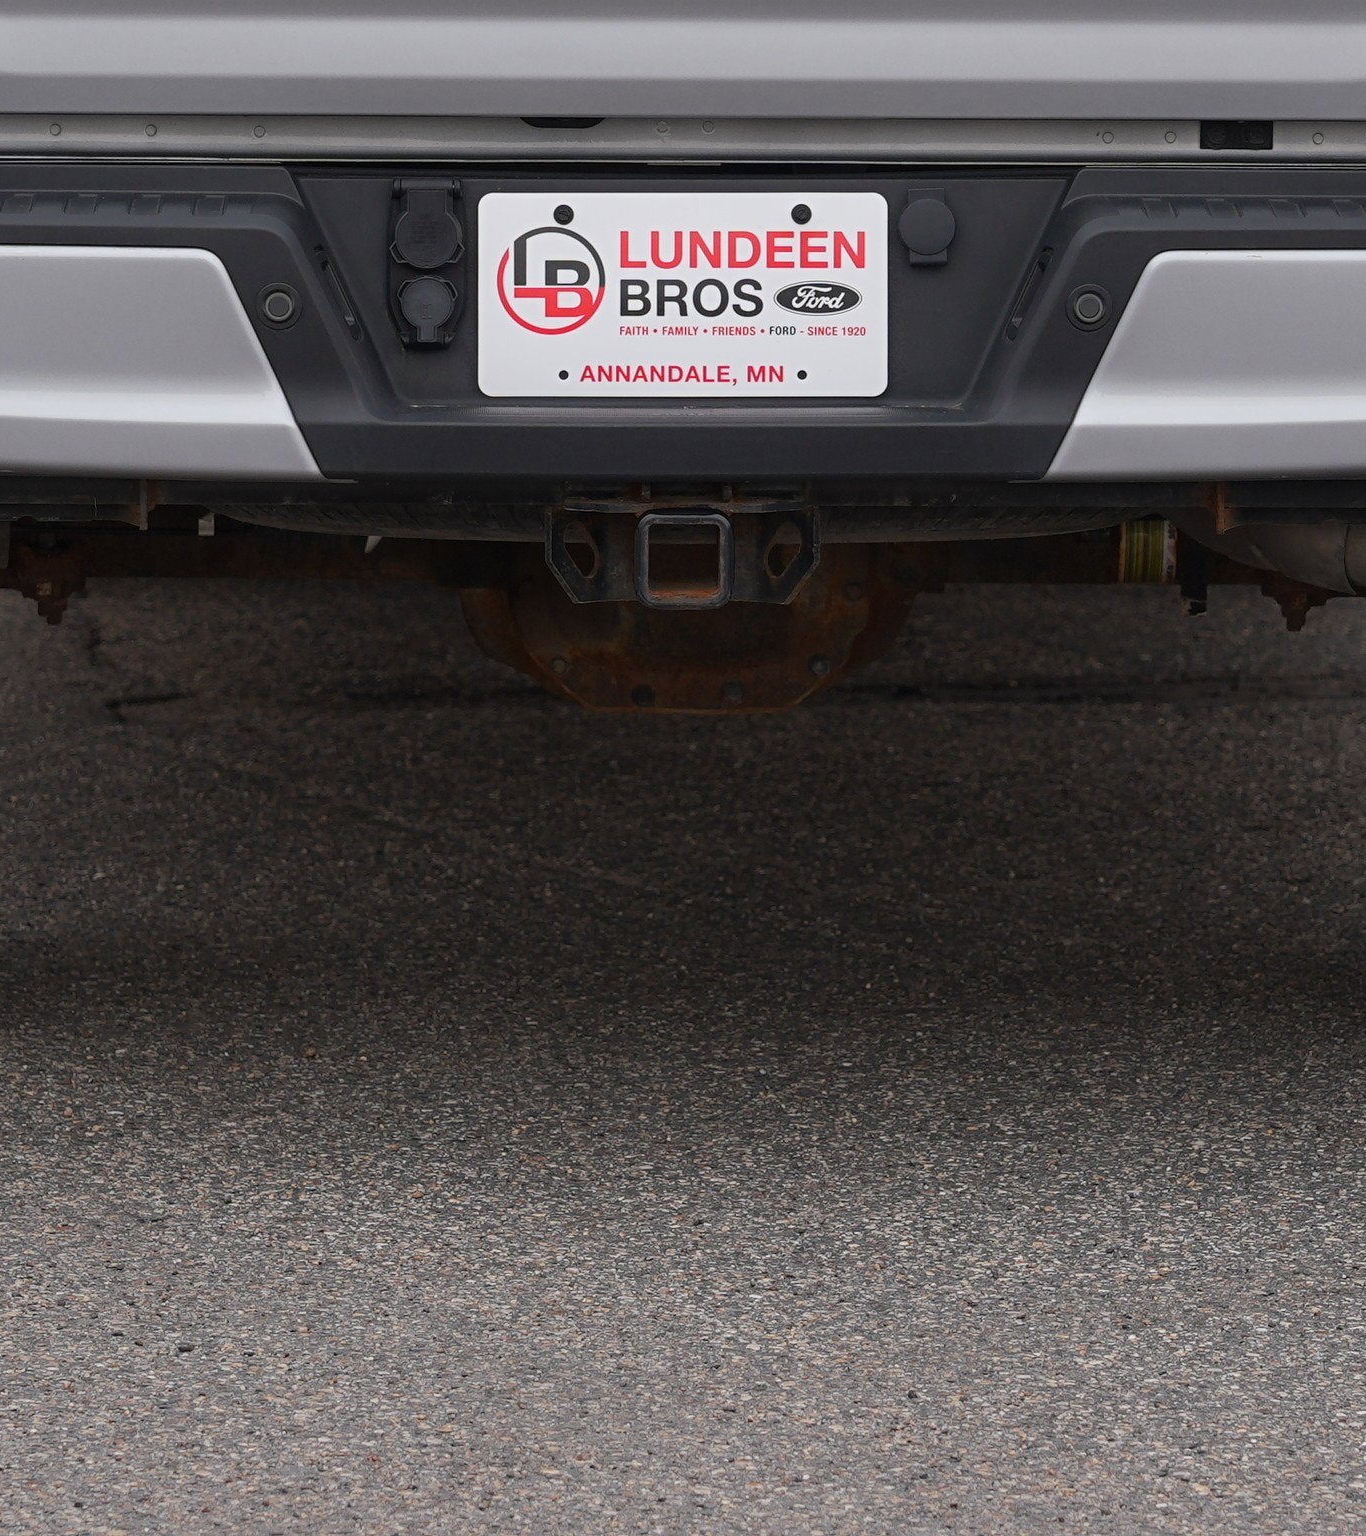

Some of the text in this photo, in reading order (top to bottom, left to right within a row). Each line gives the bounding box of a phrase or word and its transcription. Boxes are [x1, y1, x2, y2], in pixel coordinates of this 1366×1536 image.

[619, 230, 866, 270] LUNDEEN
[619, 278, 764, 318] BROS
[791, 285, 846, 309] Ford
[619, 326, 867, 337] FAITH FAMILY FRIENDS FORD SINCE 1920
[579, 364, 785, 386] ANNANDALE, MN
